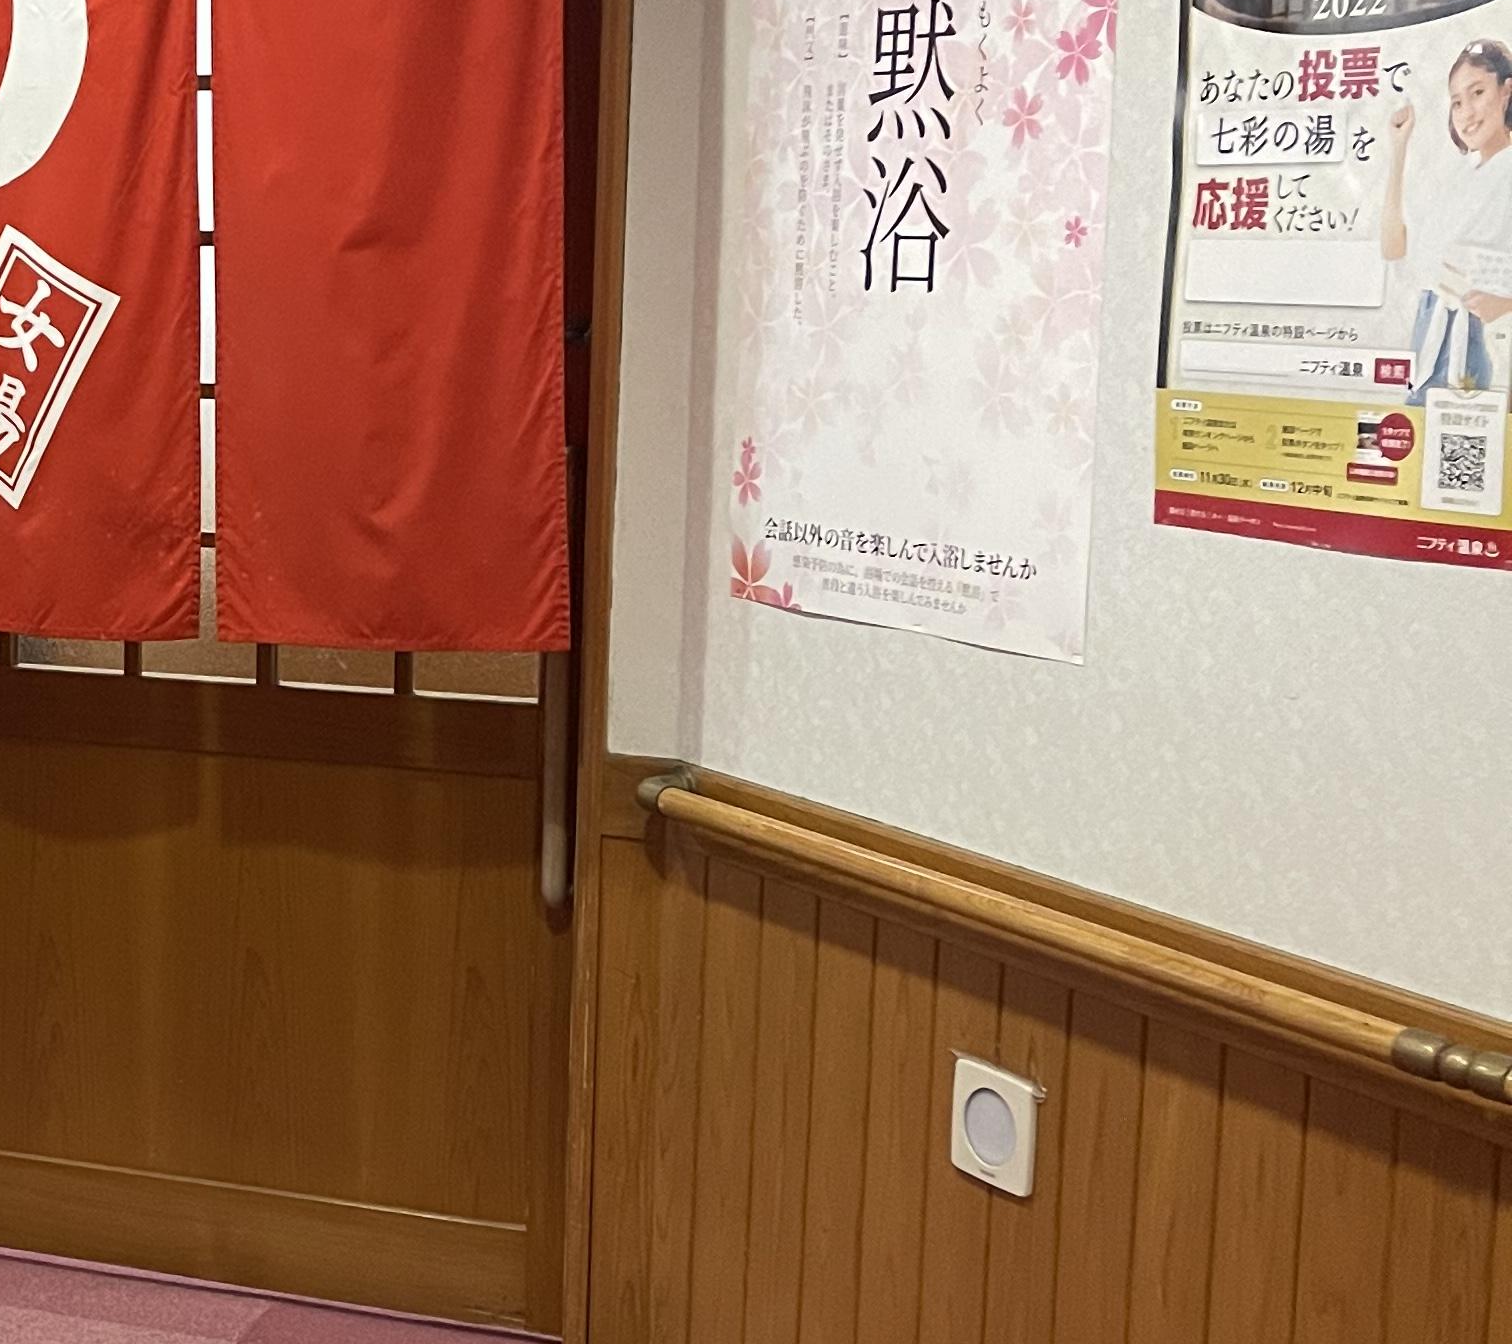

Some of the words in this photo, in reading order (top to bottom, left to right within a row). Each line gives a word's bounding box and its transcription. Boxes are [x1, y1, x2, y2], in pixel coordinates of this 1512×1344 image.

[973, 0, 991, 127] もくよく
[1200, 46, 1412, 105] あなたの投票で
[1210, 114, 1337, 157] 七彩の湯
[1352, 126, 1376, 162] を
[1191, 176, 1270, 232] 応援
[1276, 173, 1312, 200] して
[764, 516, 1037, 580] 会話以外の音を楽しんで入浴しませんか
